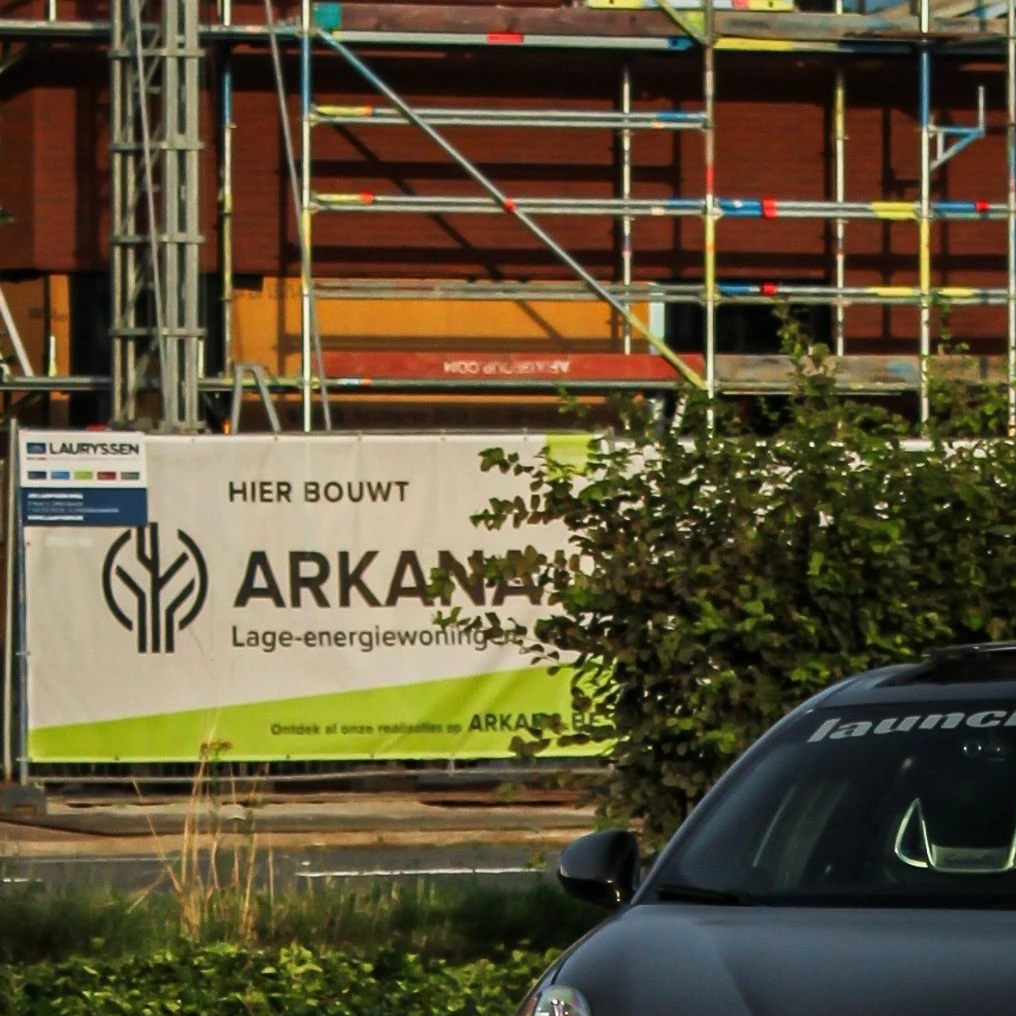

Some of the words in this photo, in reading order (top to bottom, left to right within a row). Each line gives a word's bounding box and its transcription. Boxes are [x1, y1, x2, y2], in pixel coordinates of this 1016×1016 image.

[49, 443, 139, 455] LAURYSSEN
[228, 481, 291, 503] HIER
[304, 481, 410, 503] BOUWT
